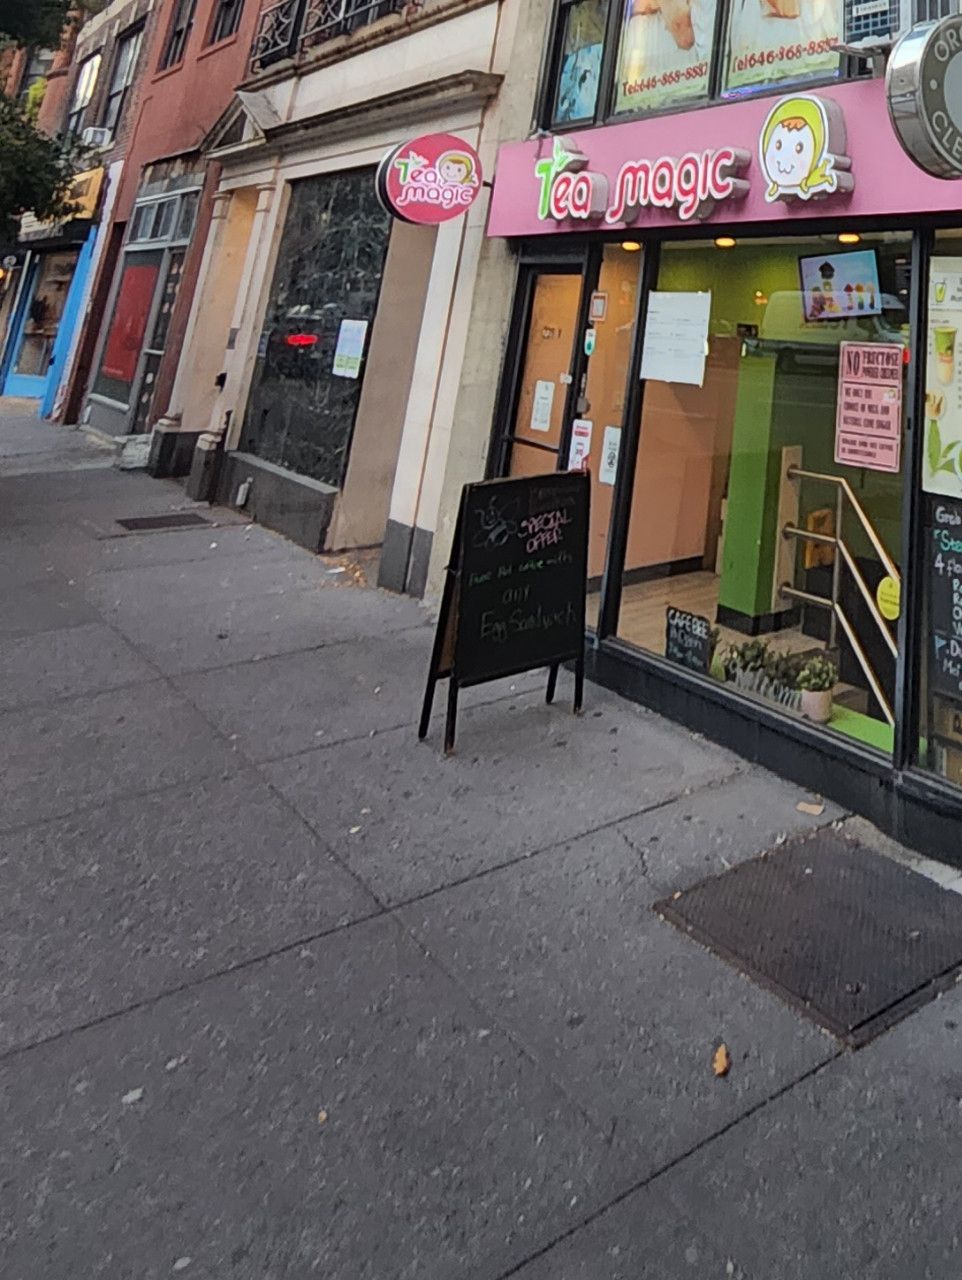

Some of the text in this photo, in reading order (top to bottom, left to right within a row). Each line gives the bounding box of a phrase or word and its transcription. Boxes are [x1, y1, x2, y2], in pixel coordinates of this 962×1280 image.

[395, 152, 438, 184] Tea
[535, 137, 594, 220] Tea
[846, 350, 861, 376] NO
[935, 507, 962, 525] Grab
[934, 553, 945, 575] 4
